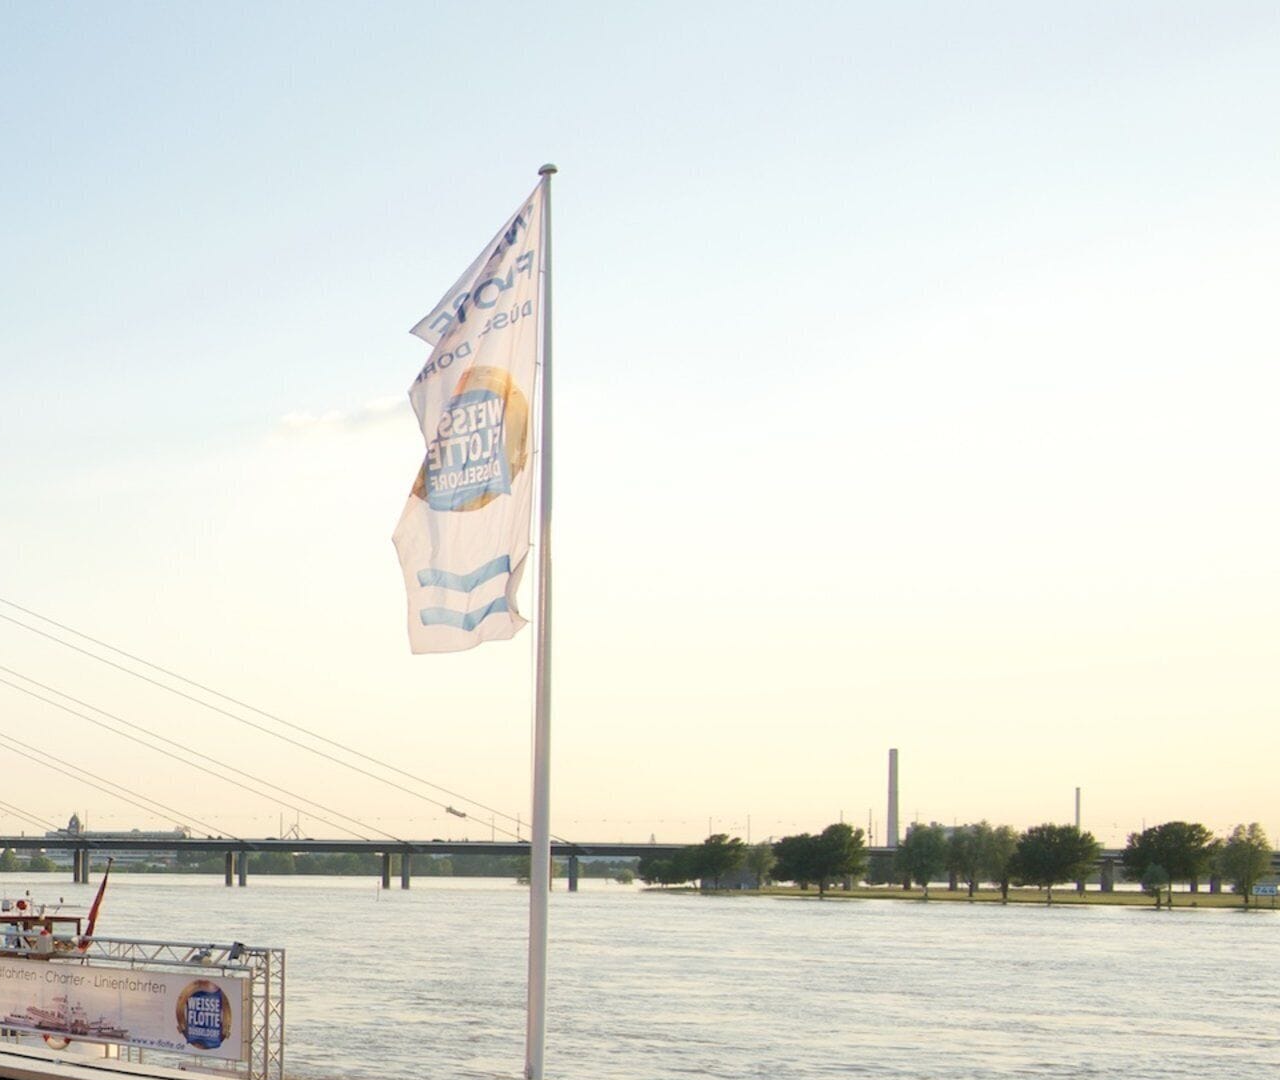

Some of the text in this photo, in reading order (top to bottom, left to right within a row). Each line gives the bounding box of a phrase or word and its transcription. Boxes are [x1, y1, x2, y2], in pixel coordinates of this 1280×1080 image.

[45, 969, 85, 986] Charter
[93, 975, 167, 994] Linienfahrten
[187, 996, 221, 1012] WEISSE
[187, 1009, 220, 1028] FLOTTE
